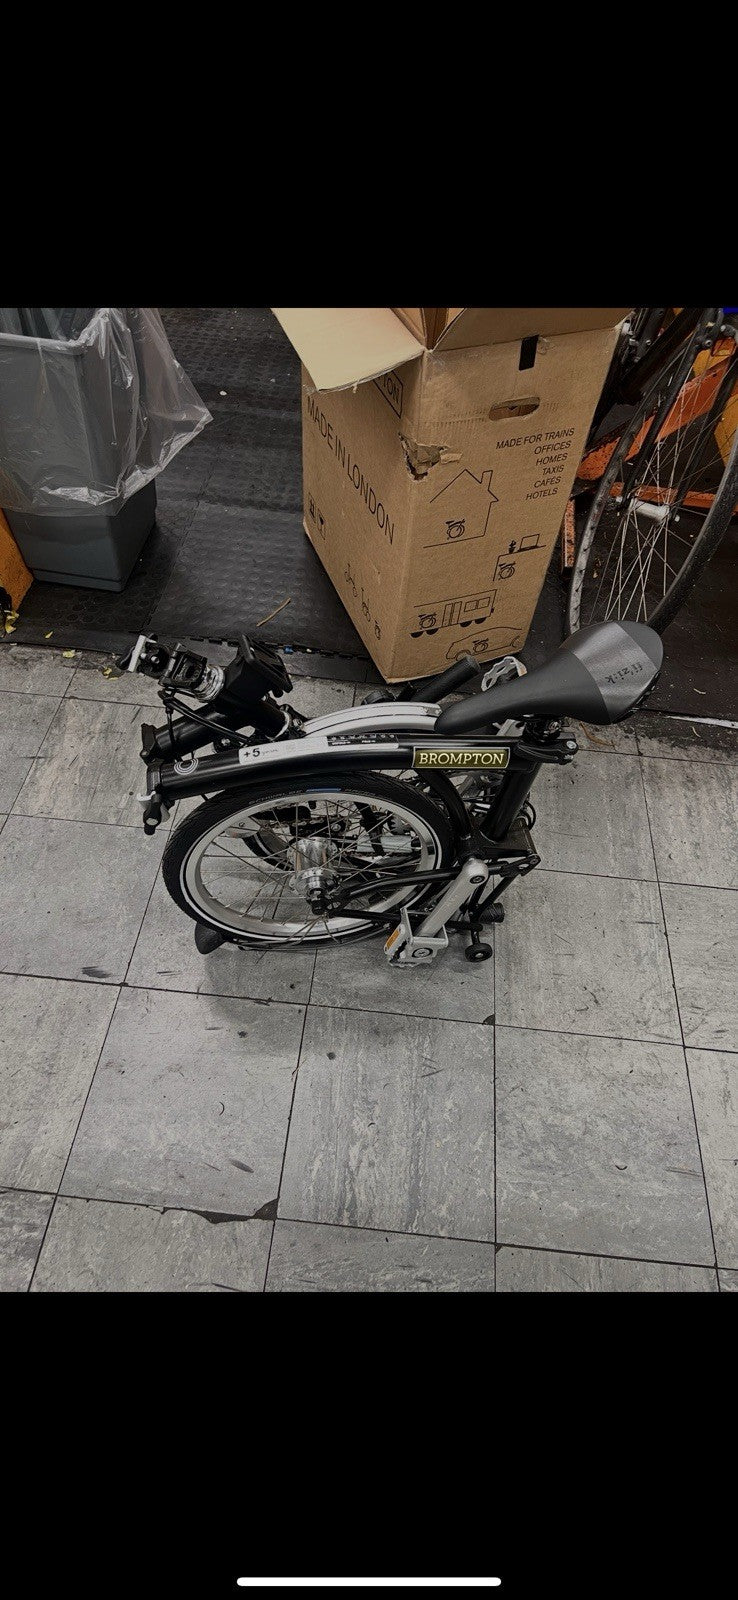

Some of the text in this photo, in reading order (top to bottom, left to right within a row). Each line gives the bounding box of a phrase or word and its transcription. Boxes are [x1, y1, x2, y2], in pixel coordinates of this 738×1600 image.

[496, 427, 575, 449] MADE FOR TRAINS
[534, 440, 572, 455] OFFICES
[535, 452, 568, 466] HOMES
[307, 396, 395, 546] MADE IN LONDON
[542, 464, 565, 476] TAXIS
[525, 487, 559, 501] HOTELS
[418, 752, 505, 765] BROMPTON
